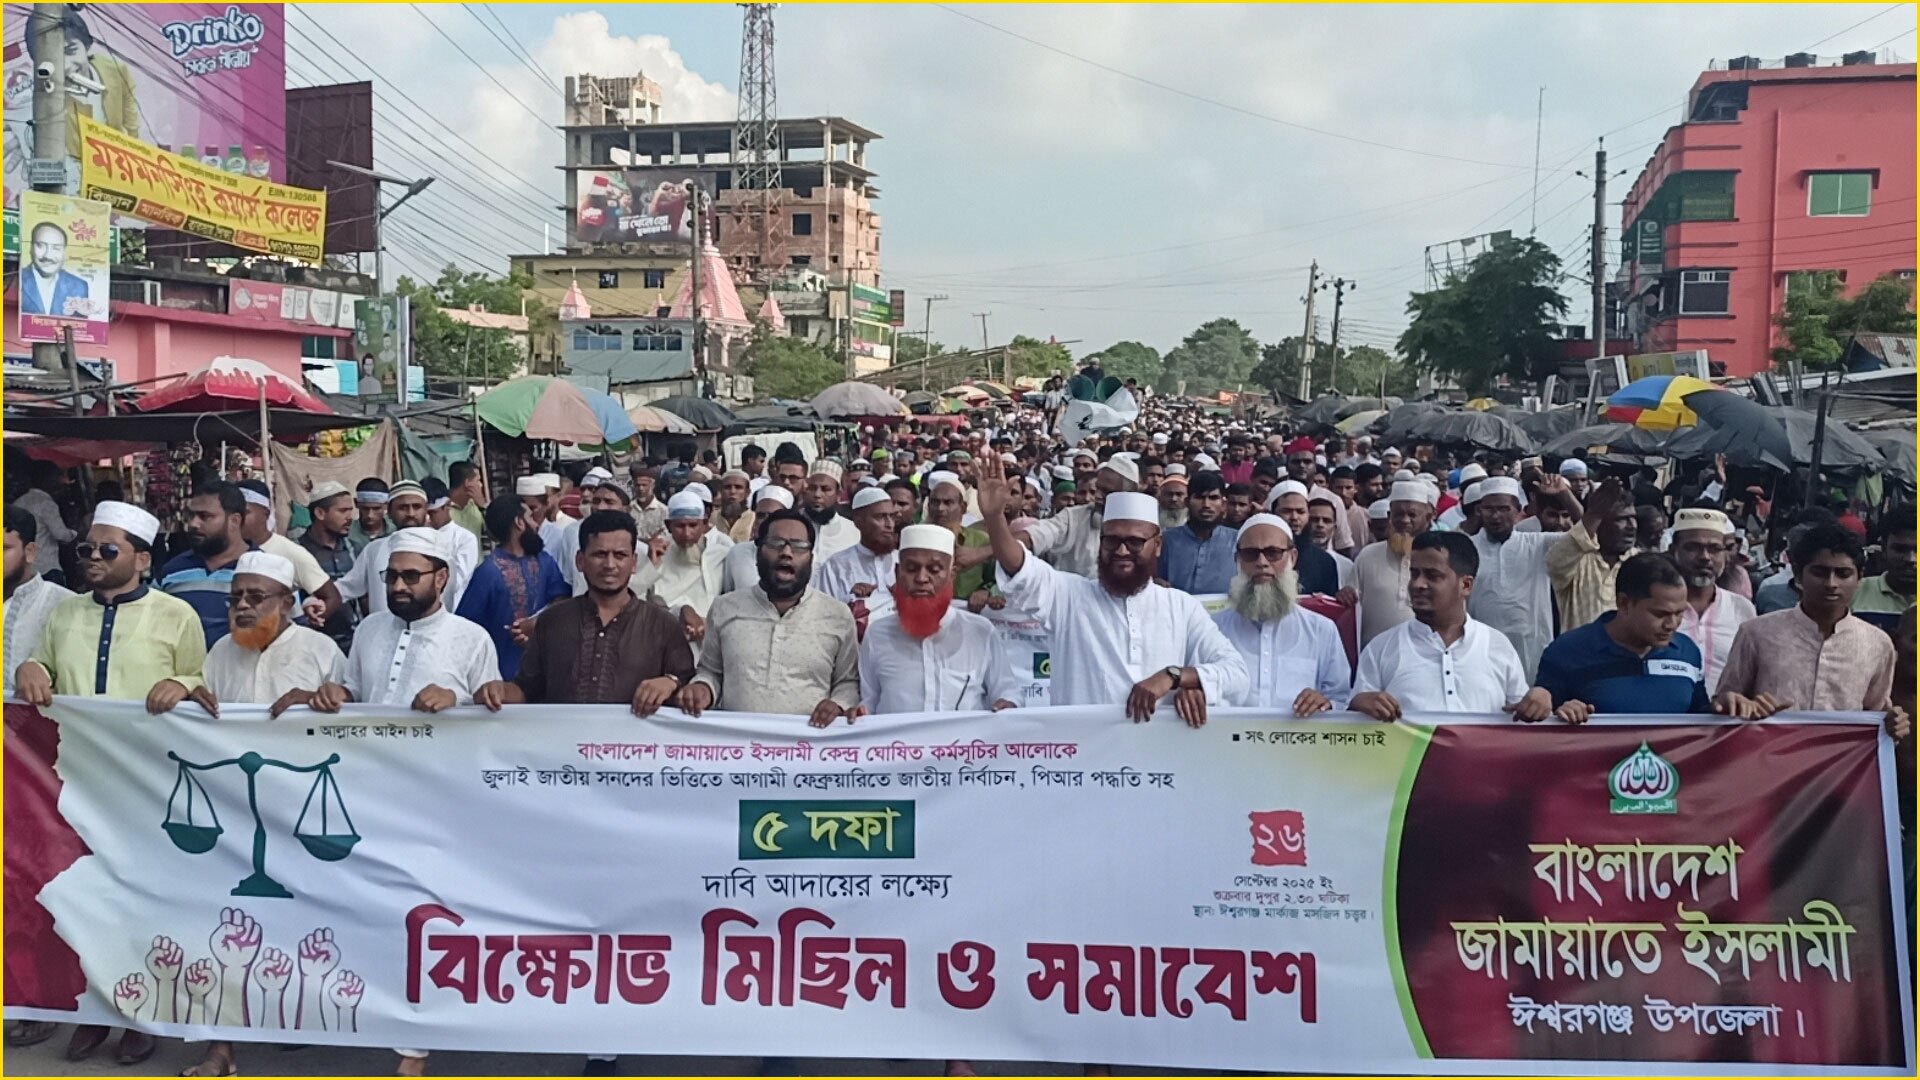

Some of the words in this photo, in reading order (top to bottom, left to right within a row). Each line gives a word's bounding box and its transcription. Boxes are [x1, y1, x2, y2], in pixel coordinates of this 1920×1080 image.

[162, 7, 261, 56] Drinko
[86, 135, 211, 216] ময়মনসিংহ
[263, 200, 321, 235] কলেজ
[320, 726, 367, 738] আল্লাহর
[373, 723, 406, 738] আইন
[412, 724, 434, 738] চাই
[1245, 731, 1265, 743] সৎ
[1269, 731, 1316, 744] লোকের
[1322, 732, 1357, 745] শাসন
[1362, 730, 1386, 746] চাই
[578, 743, 657, 760] বাংলাদেশ
[665, 743, 743, 761] জামায়াতে
[751, 741, 813, 761] ইসলামী
[820, 745, 860, 763] কেন্দ্র
[866, 741, 923, 762] ঘোষিত
[930, 739, 999, 765] কর্মসূচির
[1005, 742, 1078, 760] আলোকে
[482, 765, 530, 789] জুলাই
[537, 764, 589, 786] জাতীয়
[596, 771, 653, 787] সনদের
[660, 766, 723, 788] ভিত্তিতে
[730, 766, 787, 788] আগামী
[793, 767, 891, 790] ফেব্রুয়ারিতে
[897, 765, 951, 787] জাতীয়
[1031, 766, 1084, 788] পিআর
[1091, 767, 1142, 788] পদ্ধতি
[1148, 772, 1175, 789] সহ
[753, 811, 789, 851] ৫
[803, 806, 901, 851] দফা
[1257, 824, 1302, 855] ২৬
[702, 868, 756, 898] দাবি
[765, 873, 873, 898] আদায়ের
[881, 874, 952, 899] লক্ষ্যে
[1234, 874, 1278, 888] সেপ্টেম্বর
[1283, 876, 1315, 889] ২০২৫
[1319, 875, 1333, 889] ইং
[1529, 836, 1744, 906] বাংলাদেশ
[1213, 890, 1251, 902] শুক্রবার
[1255, 892, 1280, 906] দুপুর
[1318, 890, 1350, 904] ঘটিকা
[1219, 903, 1260, 919] ঈশ্বরগঞ্জ
[1304, 905, 1340, 920] মসজিদ
[1450, 914, 1667, 981] জামায়াতে
[1673, 900, 1857, 985] ইসলামী
[405, 903, 672, 1004] বিক্ষোভ
[701, 907, 906, 1010] মিছিল
[937, 940, 996, 1010] ও
[1026, 942, 1317, 1024] সমাবেশ
[1507, 992, 1634, 1036] ঈশ্বরগঞ্জ
[1643, 994, 1783, 1037] উপজেলা
